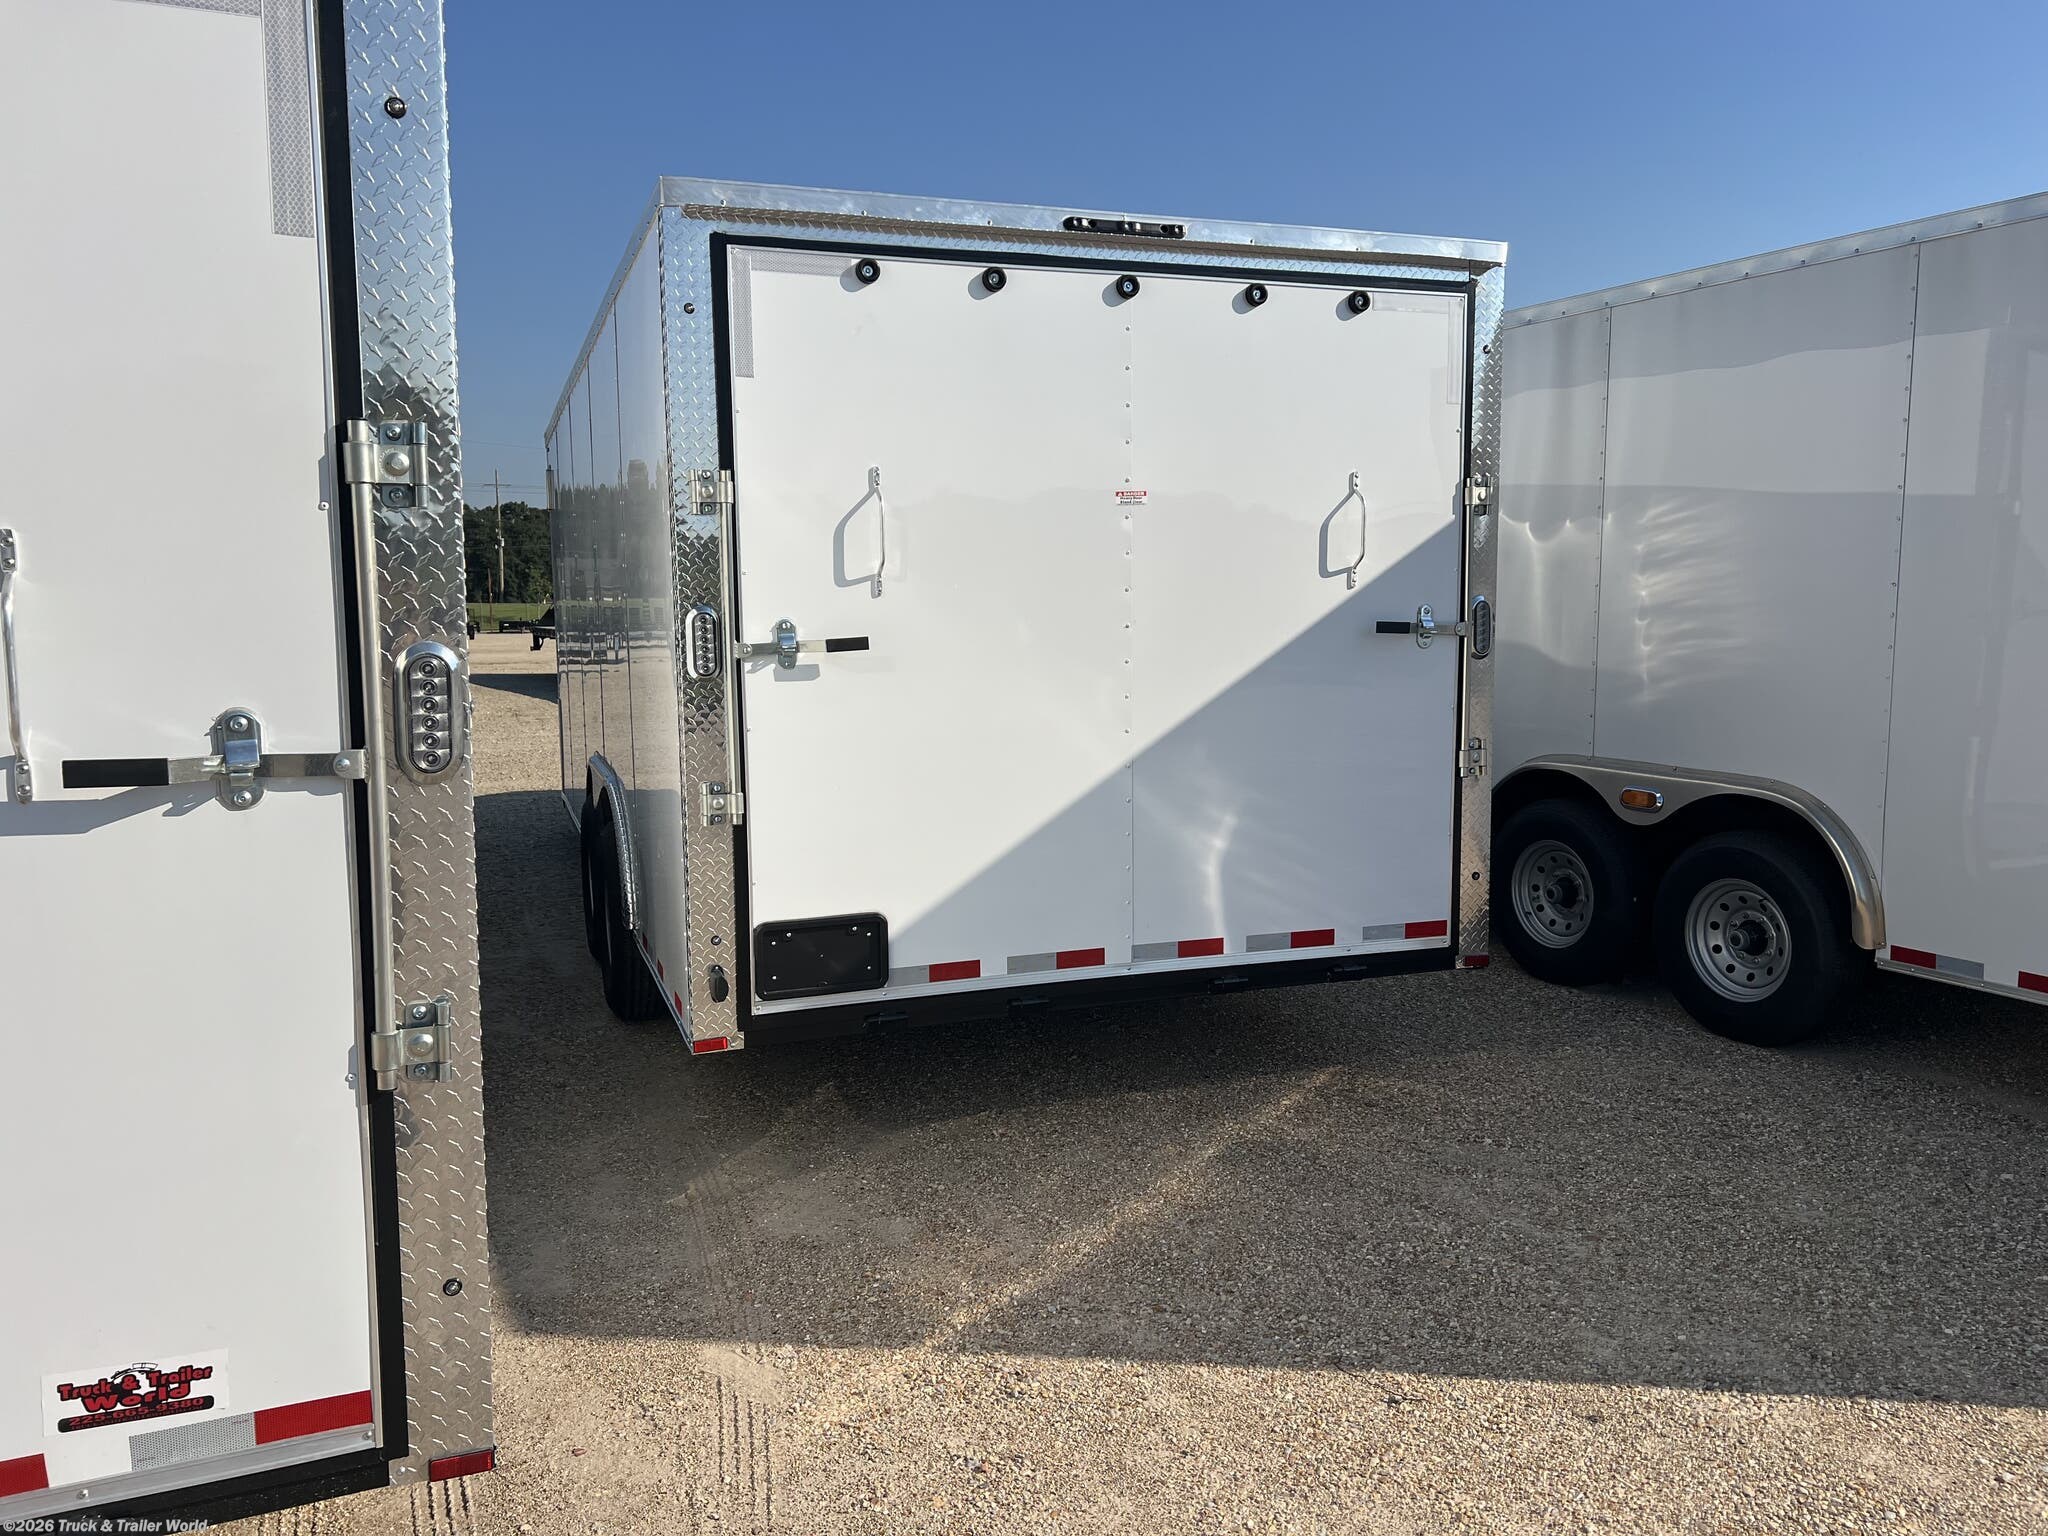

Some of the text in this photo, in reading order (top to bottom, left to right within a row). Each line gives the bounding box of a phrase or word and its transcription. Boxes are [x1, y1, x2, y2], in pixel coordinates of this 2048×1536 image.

[58, 1366, 213, 1400] Truck & Trailer
[82, 1383, 190, 1412] World
[69, 1398, 204, 1426] 225-665-9380
